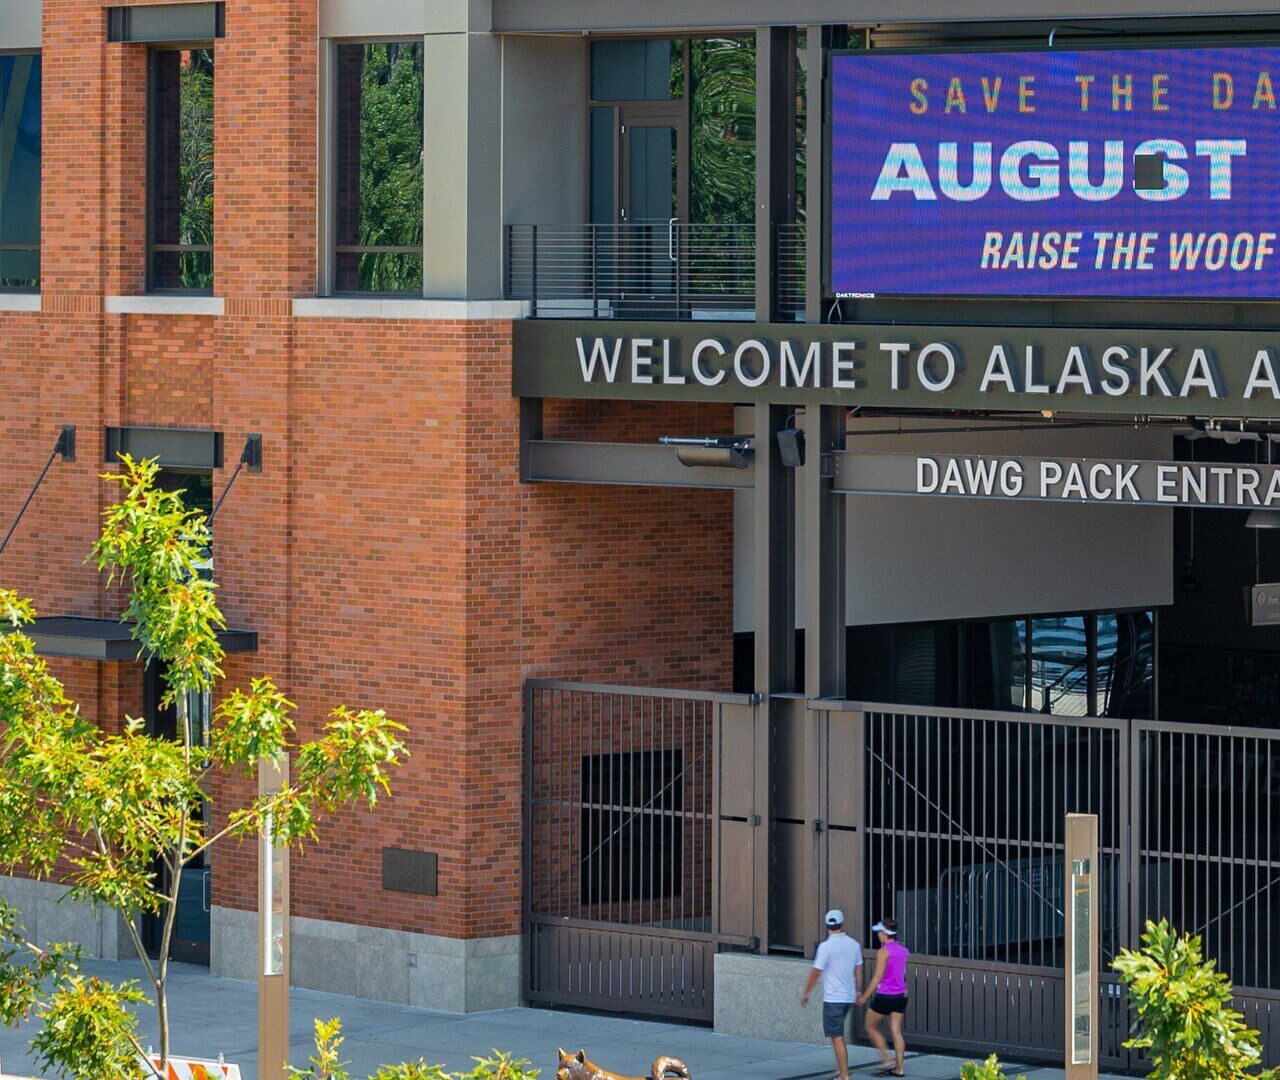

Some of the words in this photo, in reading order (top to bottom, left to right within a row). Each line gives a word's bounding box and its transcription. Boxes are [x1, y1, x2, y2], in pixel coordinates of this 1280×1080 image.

[910, 76, 1035, 115] SAVE
[1076, 73, 1169, 111] THE
[871, 139, 1246, 201] AUGUST
[982, 232, 1082, 270] RAISE
[1094, 232, 1156, 270] THE
[1170, 232, 1276, 271] WOOF
[576, 337, 857, 389] WELCOME
[880, 342, 957, 392] TO
[979, 345, 1219, 398] ALASKA
[917, 457, 1022, 496] DAWG
[1040, 461, 1141, 502] PACK
